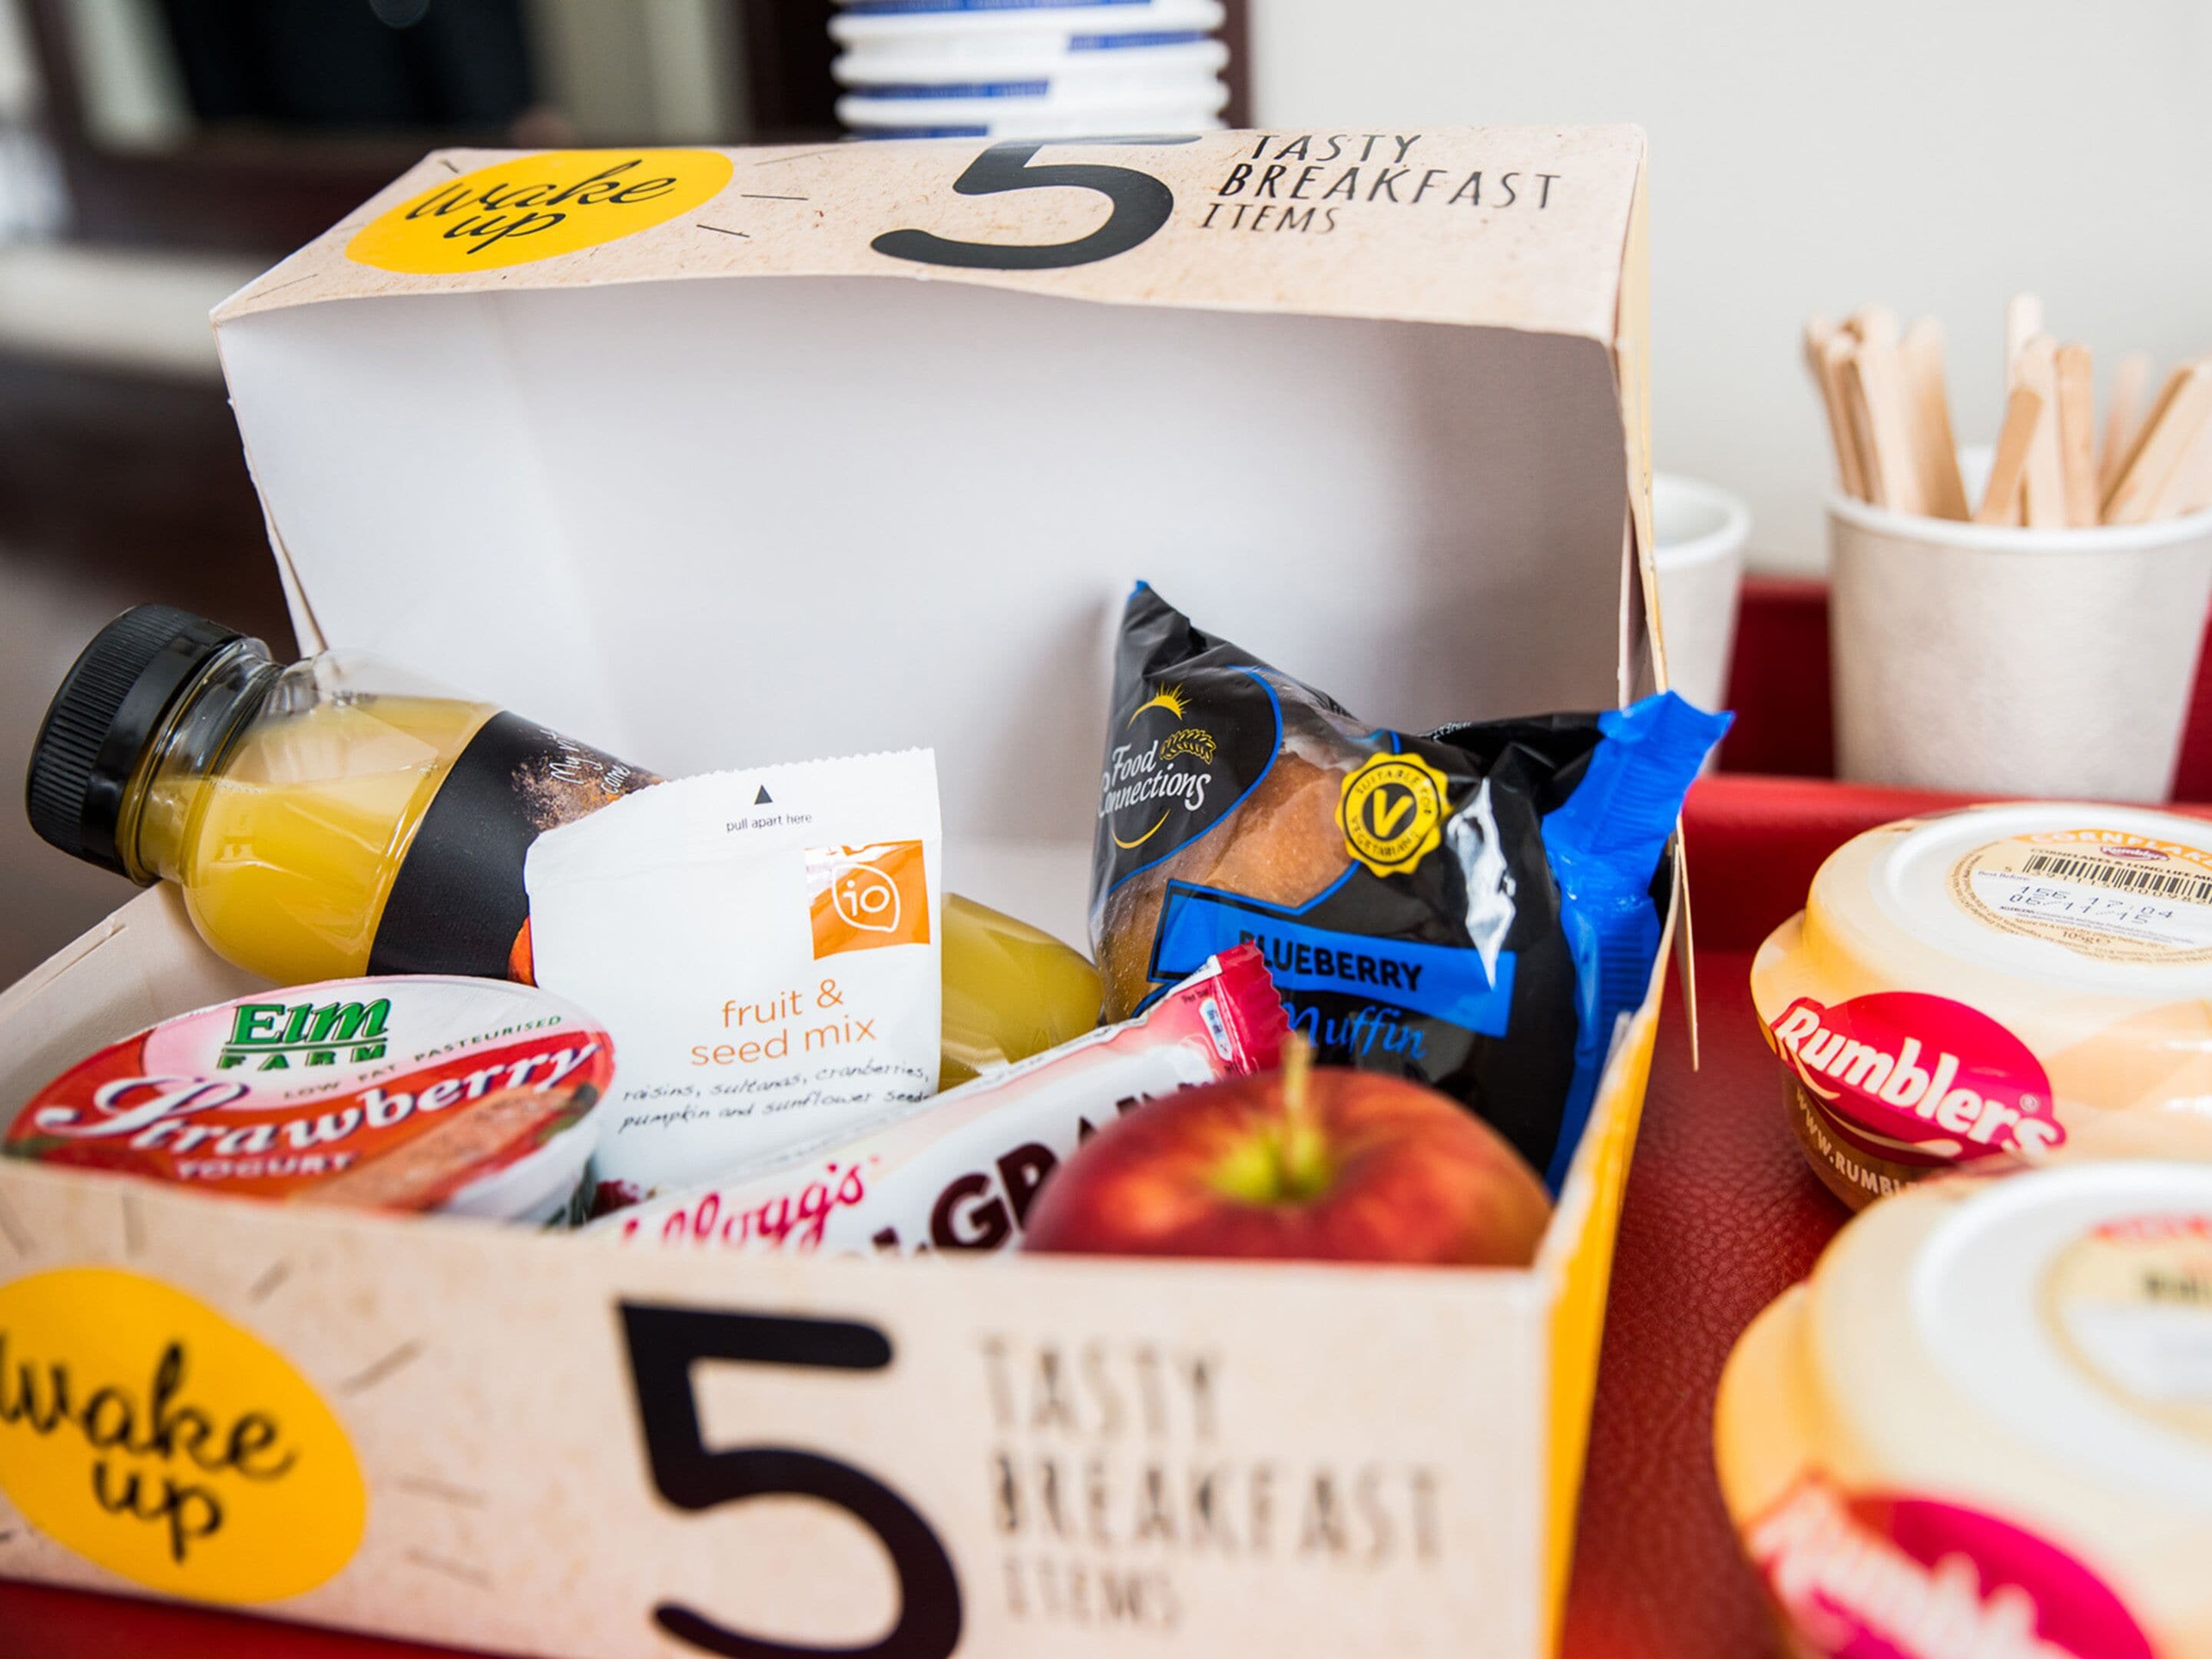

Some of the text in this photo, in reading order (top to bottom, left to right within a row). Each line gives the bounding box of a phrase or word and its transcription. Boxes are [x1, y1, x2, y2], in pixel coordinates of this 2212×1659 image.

[1250, 134, 1422, 164] TASTY
[870, 134, 1201, 269] 5
[1219, 162, 1561, 210] BREAKFAST
[443, 212, 567, 254] up
[1200, 203, 1340, 233] ITEMS
[1112, 740, 1158, 786] Food
[726, 813, 813, 833] pull apart here
[1373, 787, 1414, 838] V
[230, 998, 392, 1045] Elm
[722, 978, 844, 1028] fruit &
[217, 1044, 389, 1071] FARM
[283, 1015, 563, 1100] LOW FAT PASTEURISED
[691, 1014, 876, 1066] seed mix
[35, 1041, 601, 1155] Strawberry
[623, 1059, 929, 1102] raisins, sultanas, cranberries,
[618, 1108, 710, 1134] pumpkin
[718, 1104, 753, 1118] and
[762, 1091, 873, 1114] sunflower
[174, 1152, 356, 1181] YOGURT
[980, 1333, 1223, 1444] TASTY
[612, 1300, 963, 1659] 5
[91, 1457, 225, 1565] up
[989, 1445, 1444, 1568] BREAKFAST
